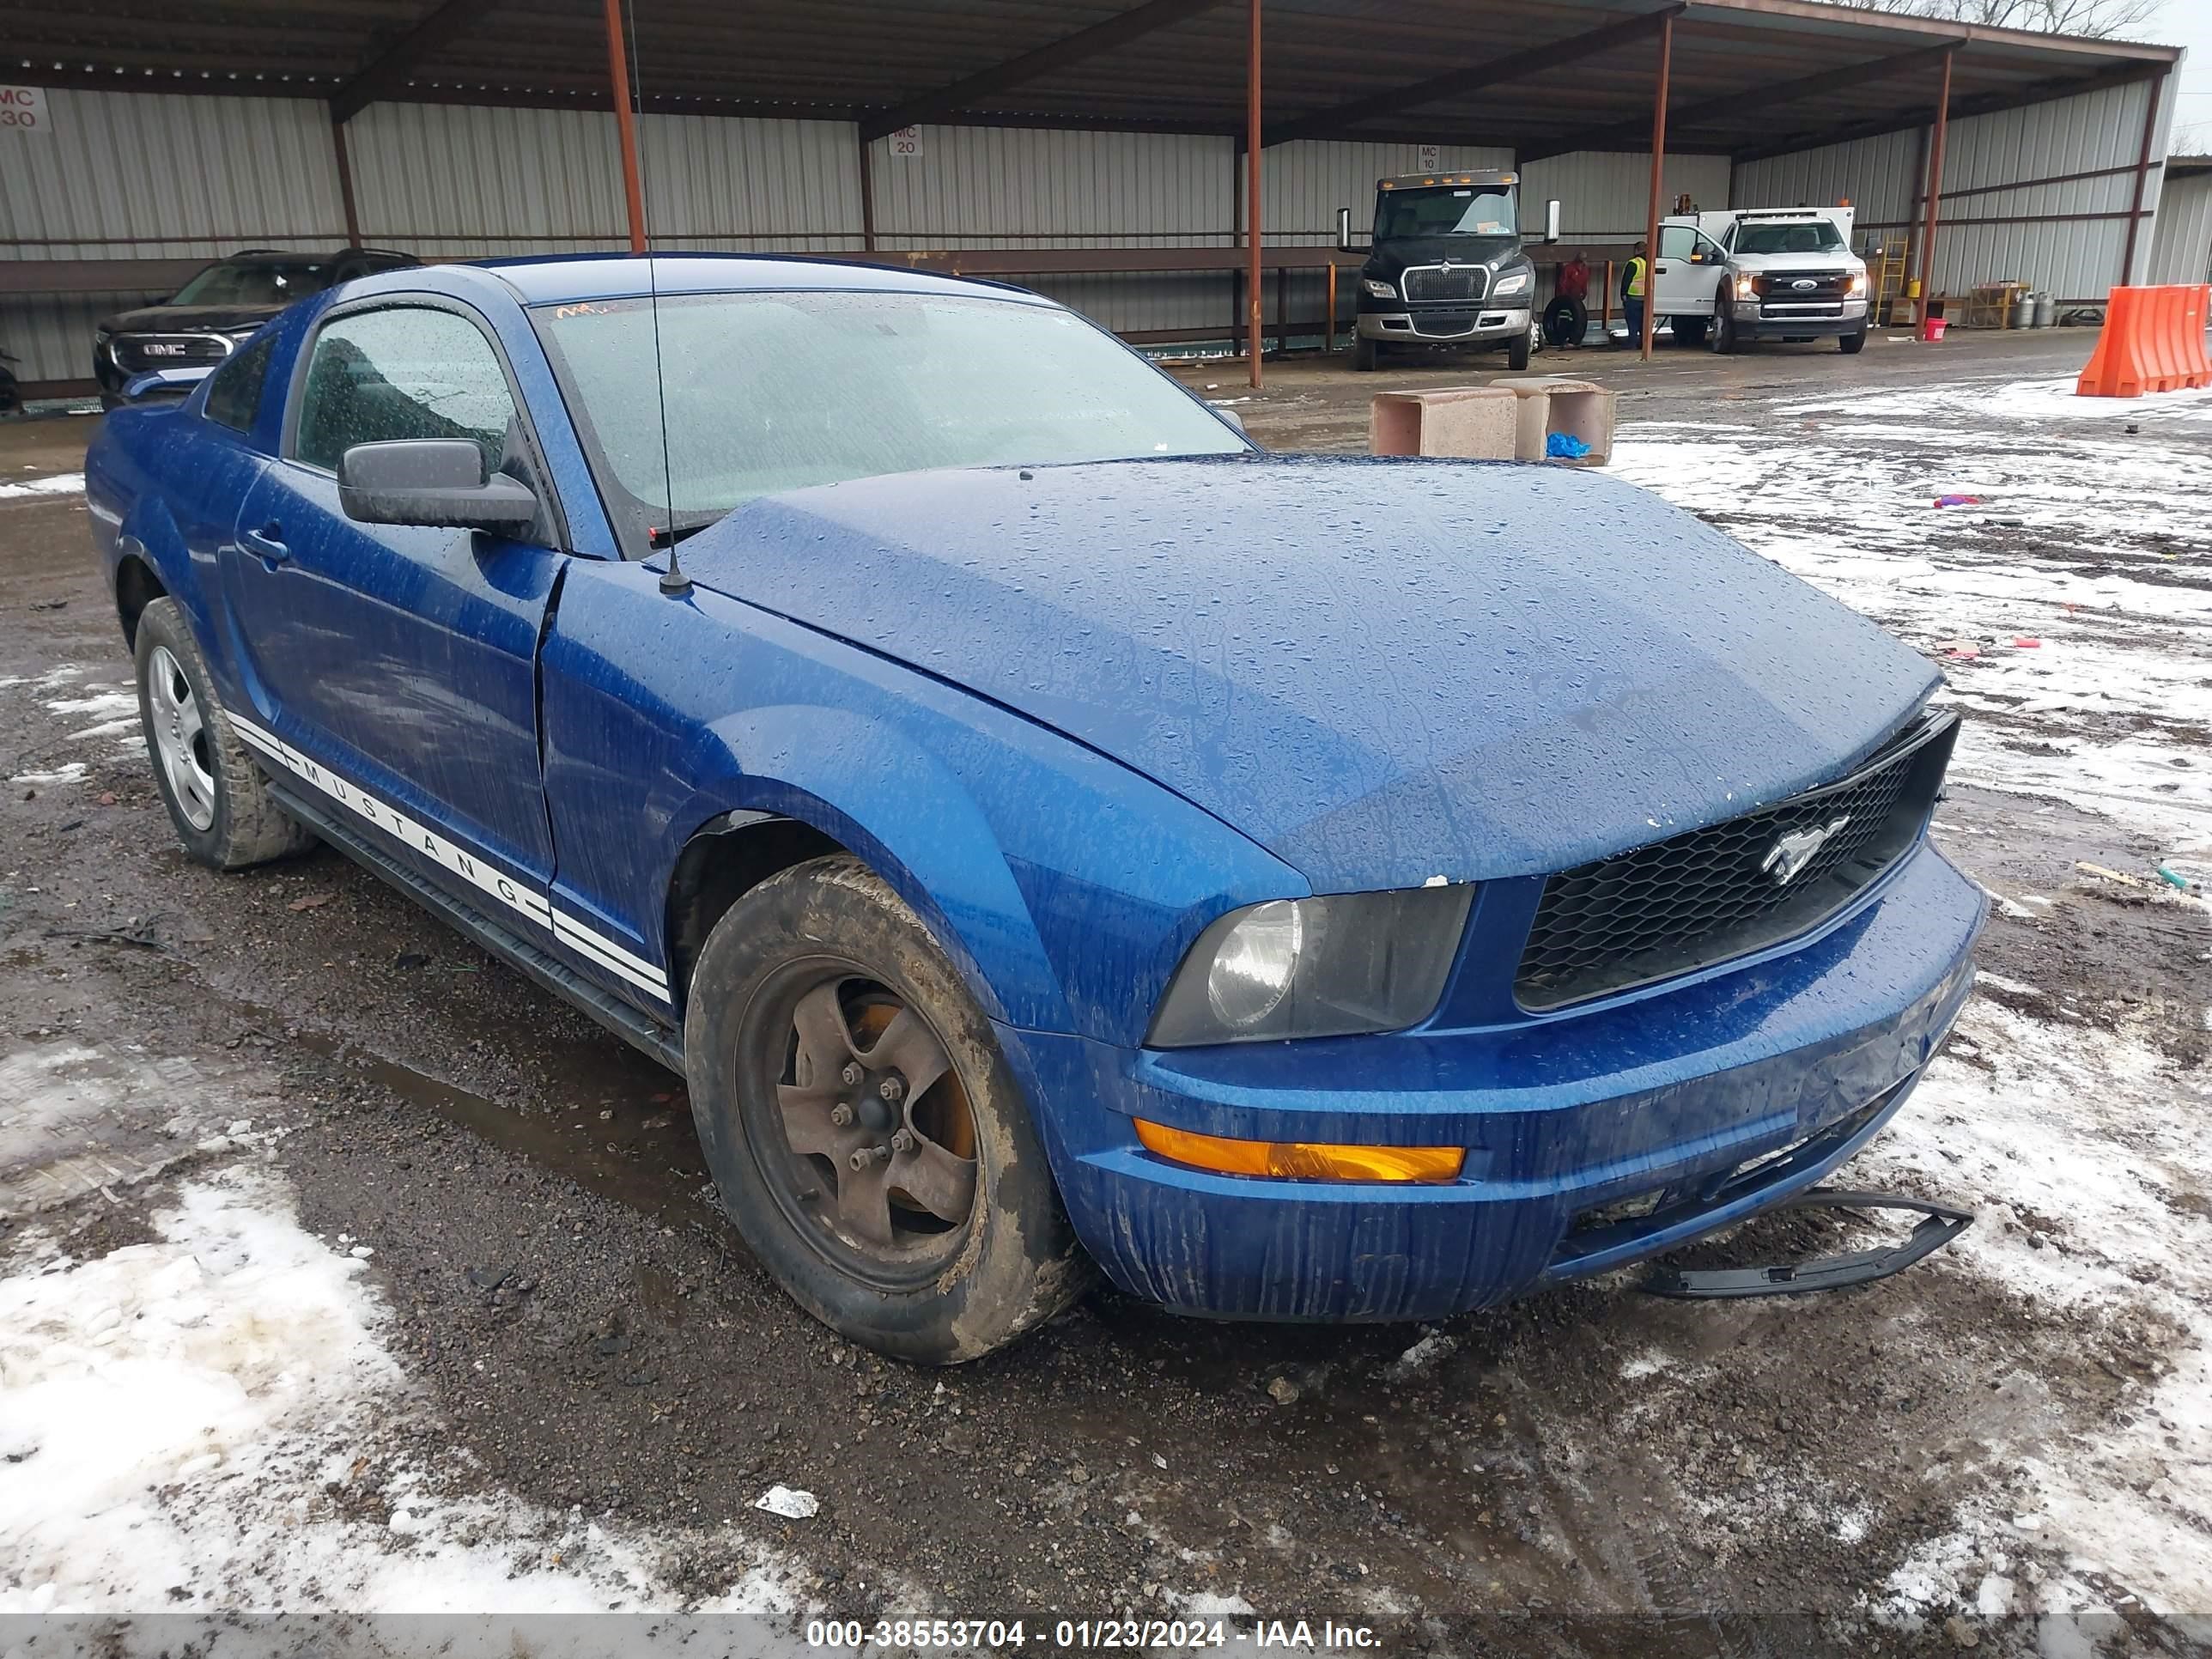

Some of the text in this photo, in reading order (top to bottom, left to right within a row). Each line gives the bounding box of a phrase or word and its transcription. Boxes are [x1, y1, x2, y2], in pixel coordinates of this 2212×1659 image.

[1, 110, 36, 127] 30
[894, 126, 916, 138] MC
[896, 141, 915, 154] 20
[1421, 147, 1437, 157] MC
[1424, 159, 1434, 169] 10
[143, 344, 186, 356] GMC
[303, 761, 519, 905] MUSTANG
